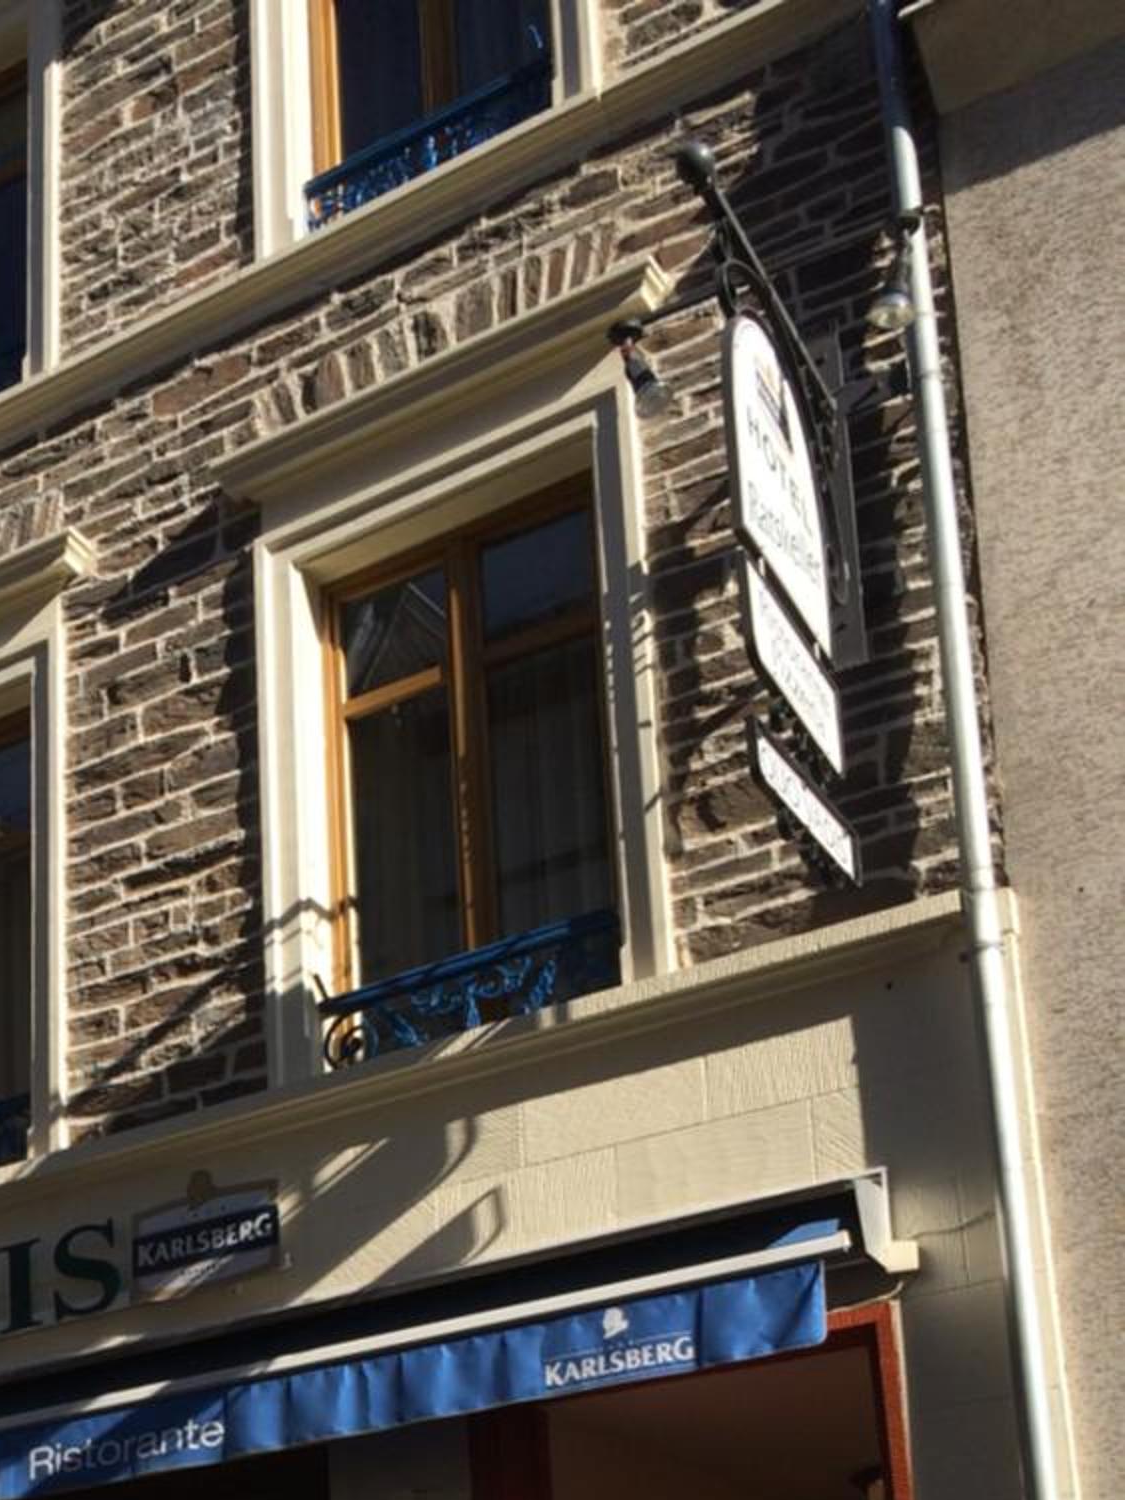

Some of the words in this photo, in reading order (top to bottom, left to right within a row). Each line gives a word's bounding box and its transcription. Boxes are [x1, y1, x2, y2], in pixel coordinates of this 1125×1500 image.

[747, 404, 813, 539] HOTEL
[138, 1212, 272, 1268] KARLSBERG
[545, 1336, 696, 1386] KARLSBERG
[28, 1418, 226, 1481] Ristorante
